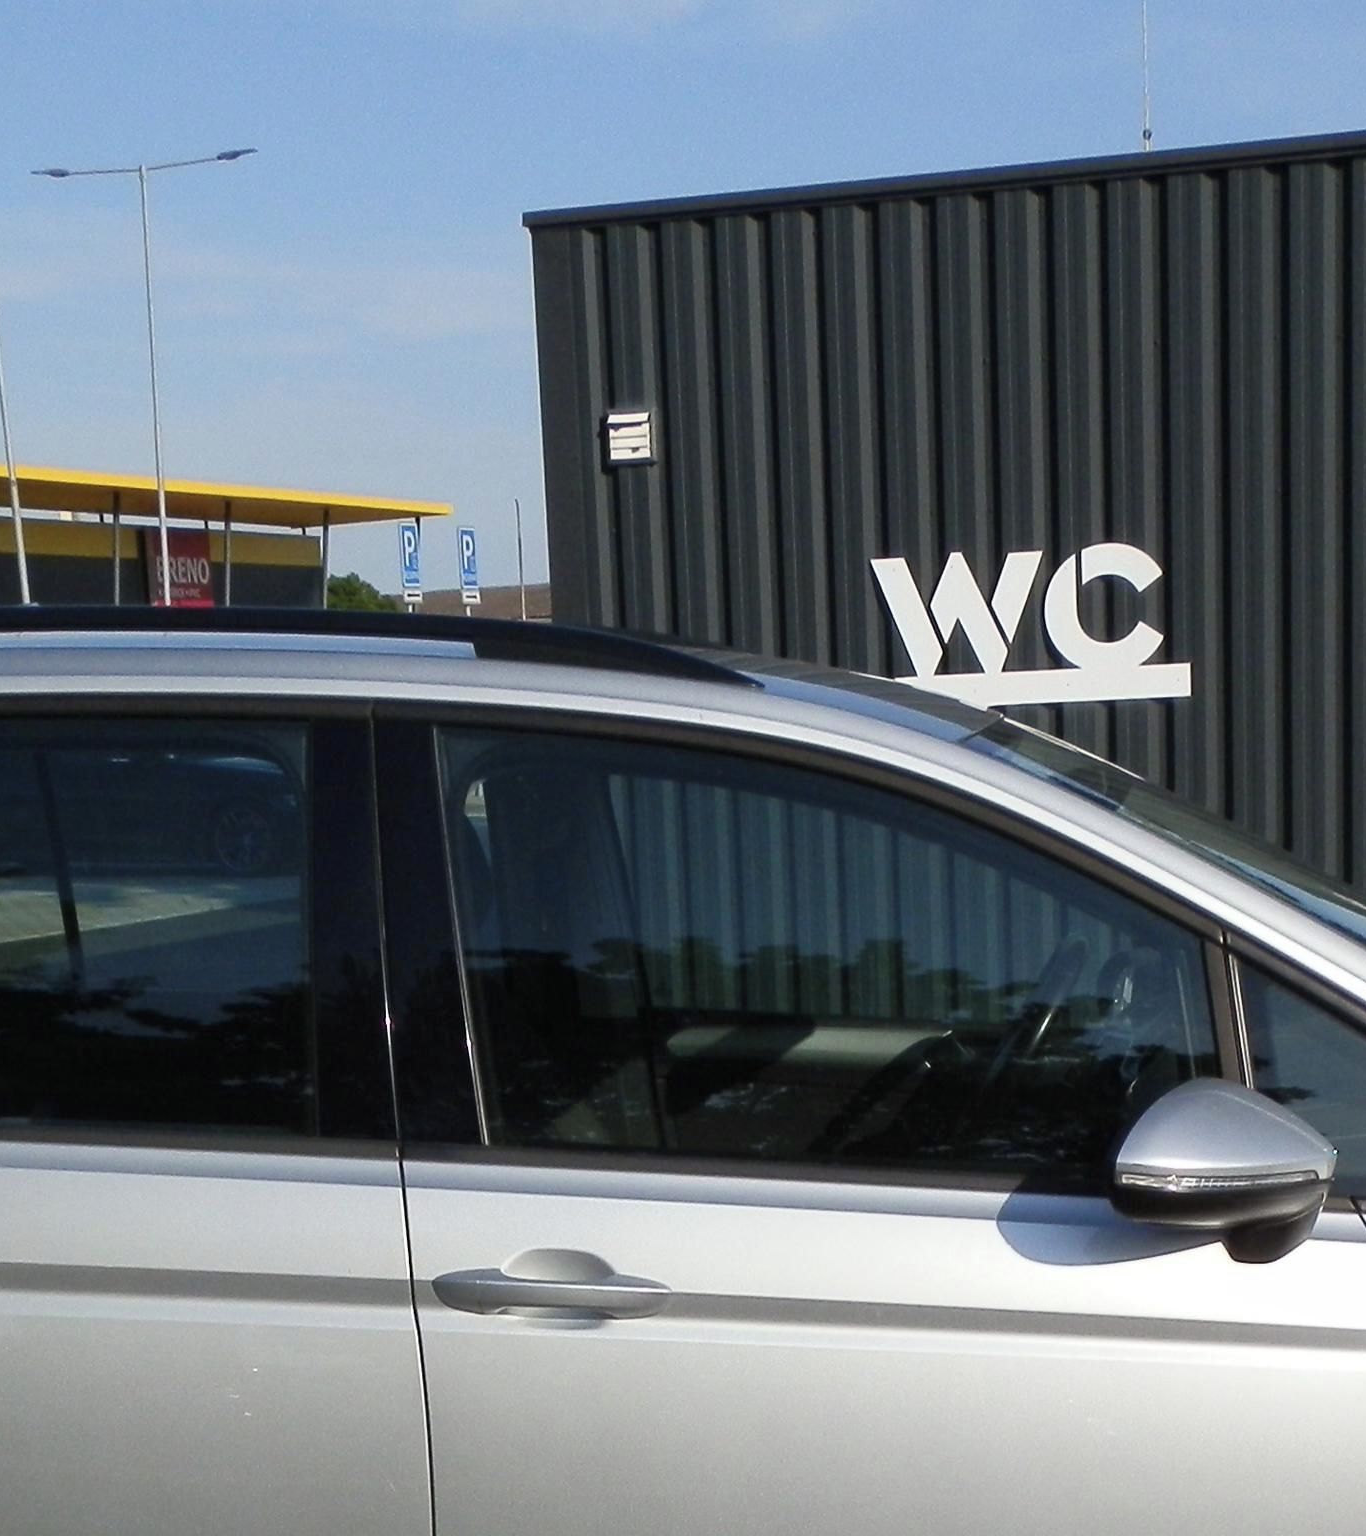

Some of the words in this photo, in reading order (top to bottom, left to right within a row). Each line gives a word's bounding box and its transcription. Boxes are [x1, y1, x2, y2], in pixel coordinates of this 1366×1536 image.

[404, 530, 415, 567] P
[462, 534, 474, 570] P
[869, 542, 1165, 680] WC
